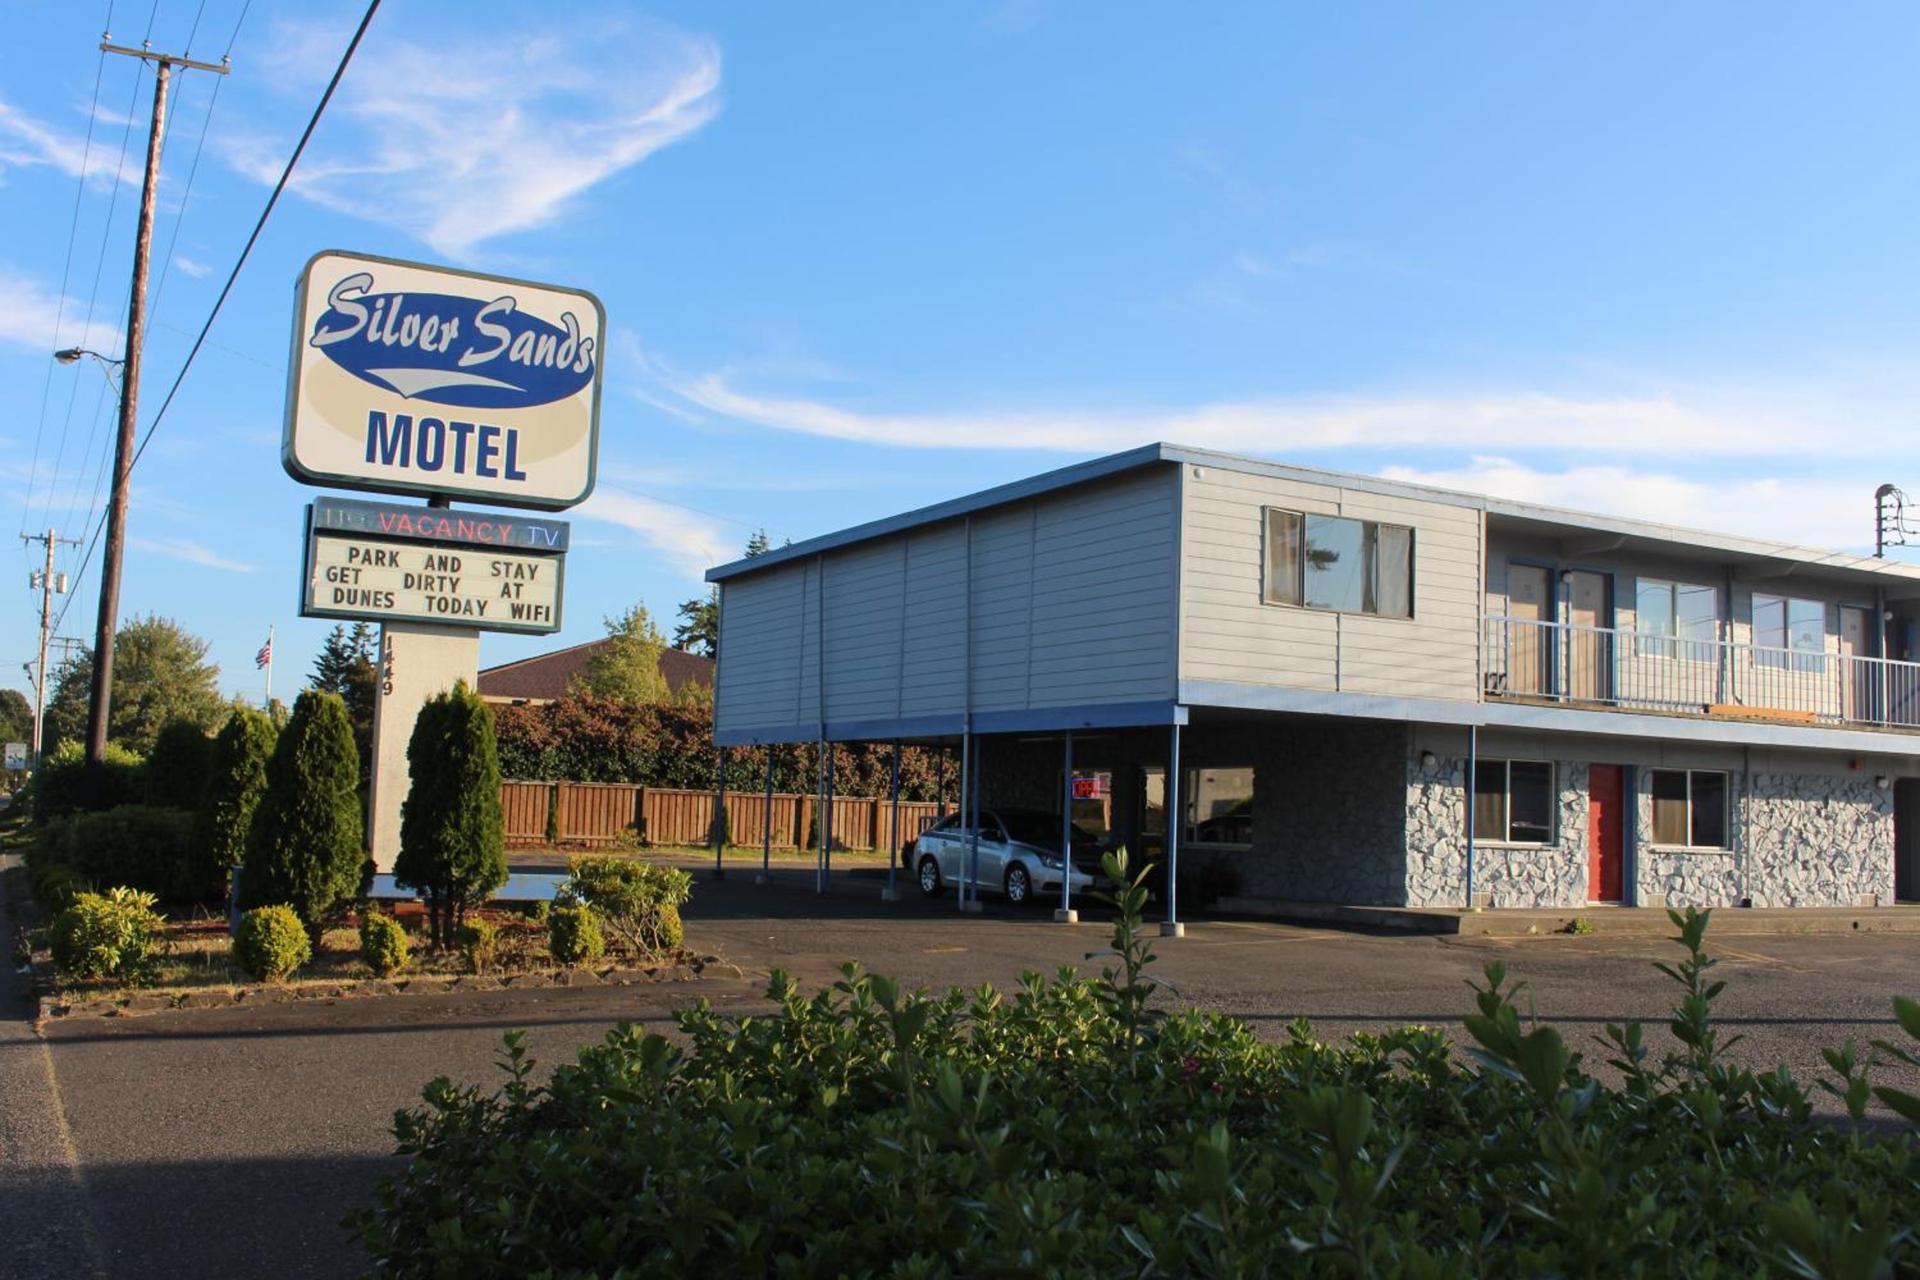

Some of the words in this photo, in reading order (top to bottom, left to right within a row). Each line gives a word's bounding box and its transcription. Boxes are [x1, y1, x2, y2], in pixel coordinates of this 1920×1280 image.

[309, 272, 459, 353] Silver
[458, 296, 595, 374] Sands
[365, 410, 527, 482] MOTEL
[379, 511, 512, 544] VACANCY
[528, 525, 559, 546] TV
[348, 546, 400, 568] PARK
[424, 554, 462, 573] AND
[491, 561, 539, 581] STAY
[326, 566, 362, 585] GET
[403, 573, 460, 593] DIRTY
[500, 582, 524, 599] AT
[333, 588, 395, 609] DUNES
[425, 595, 488, 617] TODAY
[511, 602, 551, 622] WIFI
